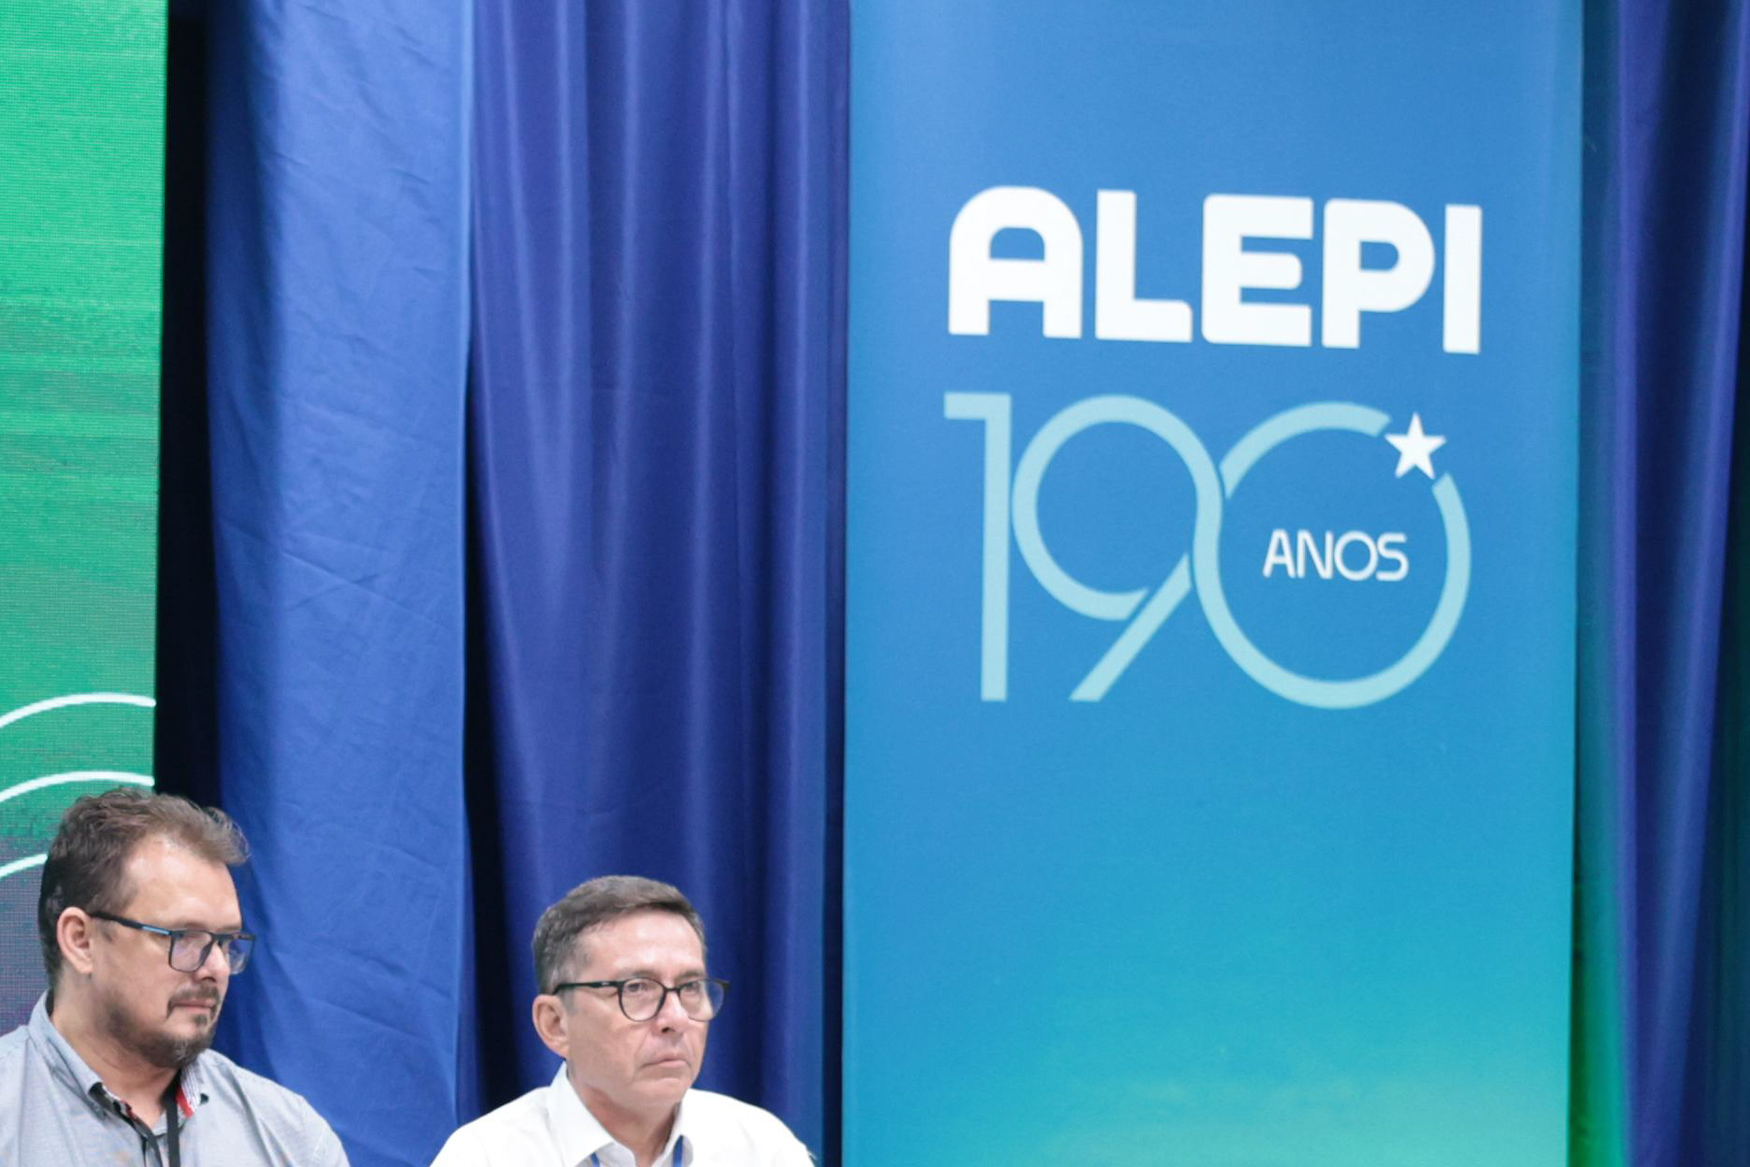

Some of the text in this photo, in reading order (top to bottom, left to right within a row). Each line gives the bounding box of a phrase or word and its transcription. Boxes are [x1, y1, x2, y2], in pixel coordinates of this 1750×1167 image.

[948, 186, 1482, 354] ALEPI
[944, 392, 1471, 709] 190
[1262, 529, 1409, 581] ANOS
